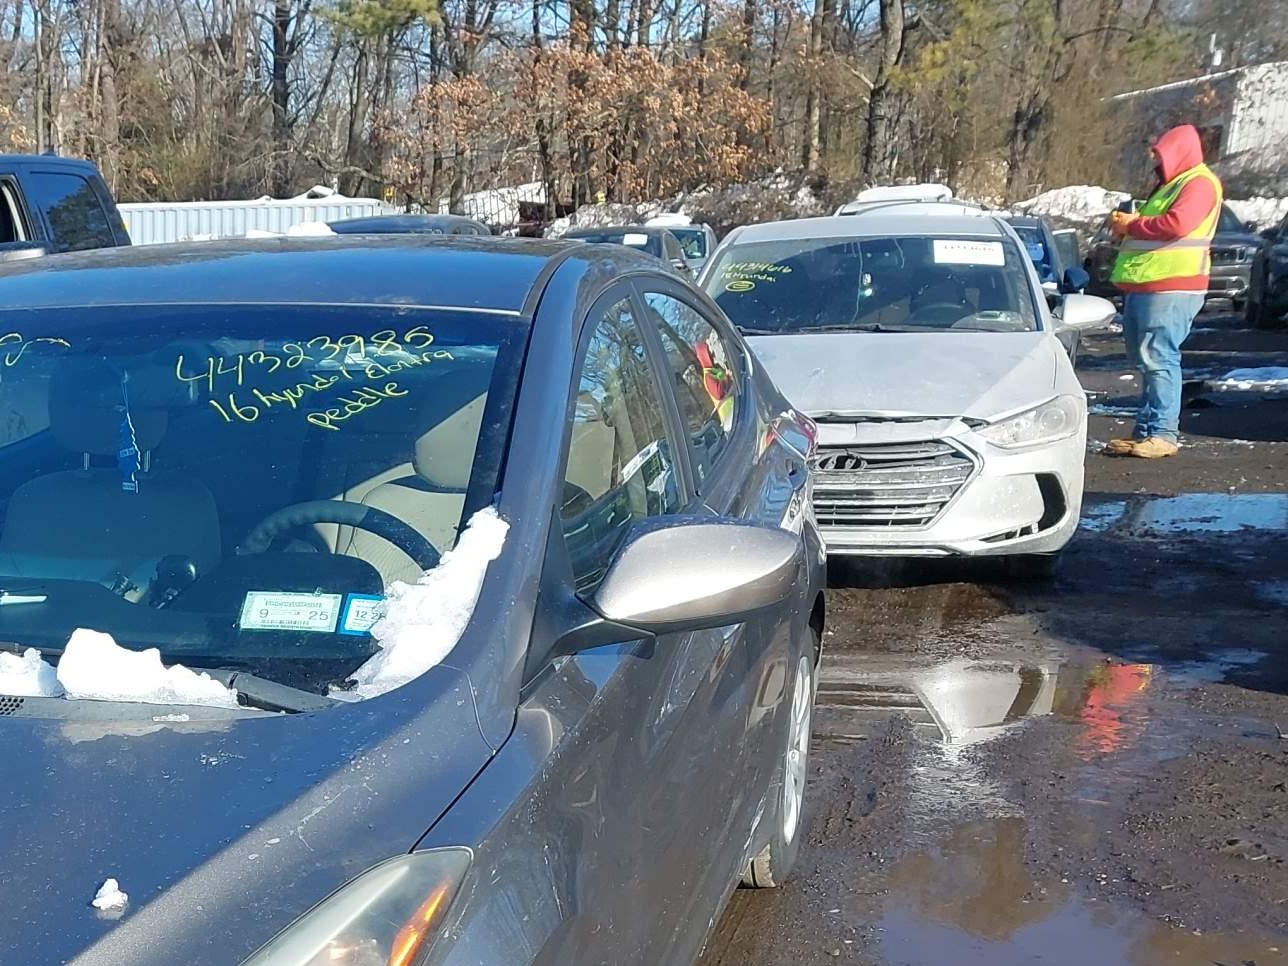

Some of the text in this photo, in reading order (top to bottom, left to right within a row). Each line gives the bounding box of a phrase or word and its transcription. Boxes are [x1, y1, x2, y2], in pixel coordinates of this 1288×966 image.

[176, 325, 434, 393] 44323985
[209, 394, 259, 422] 16
[259, 608, 329, 621] 9 25
